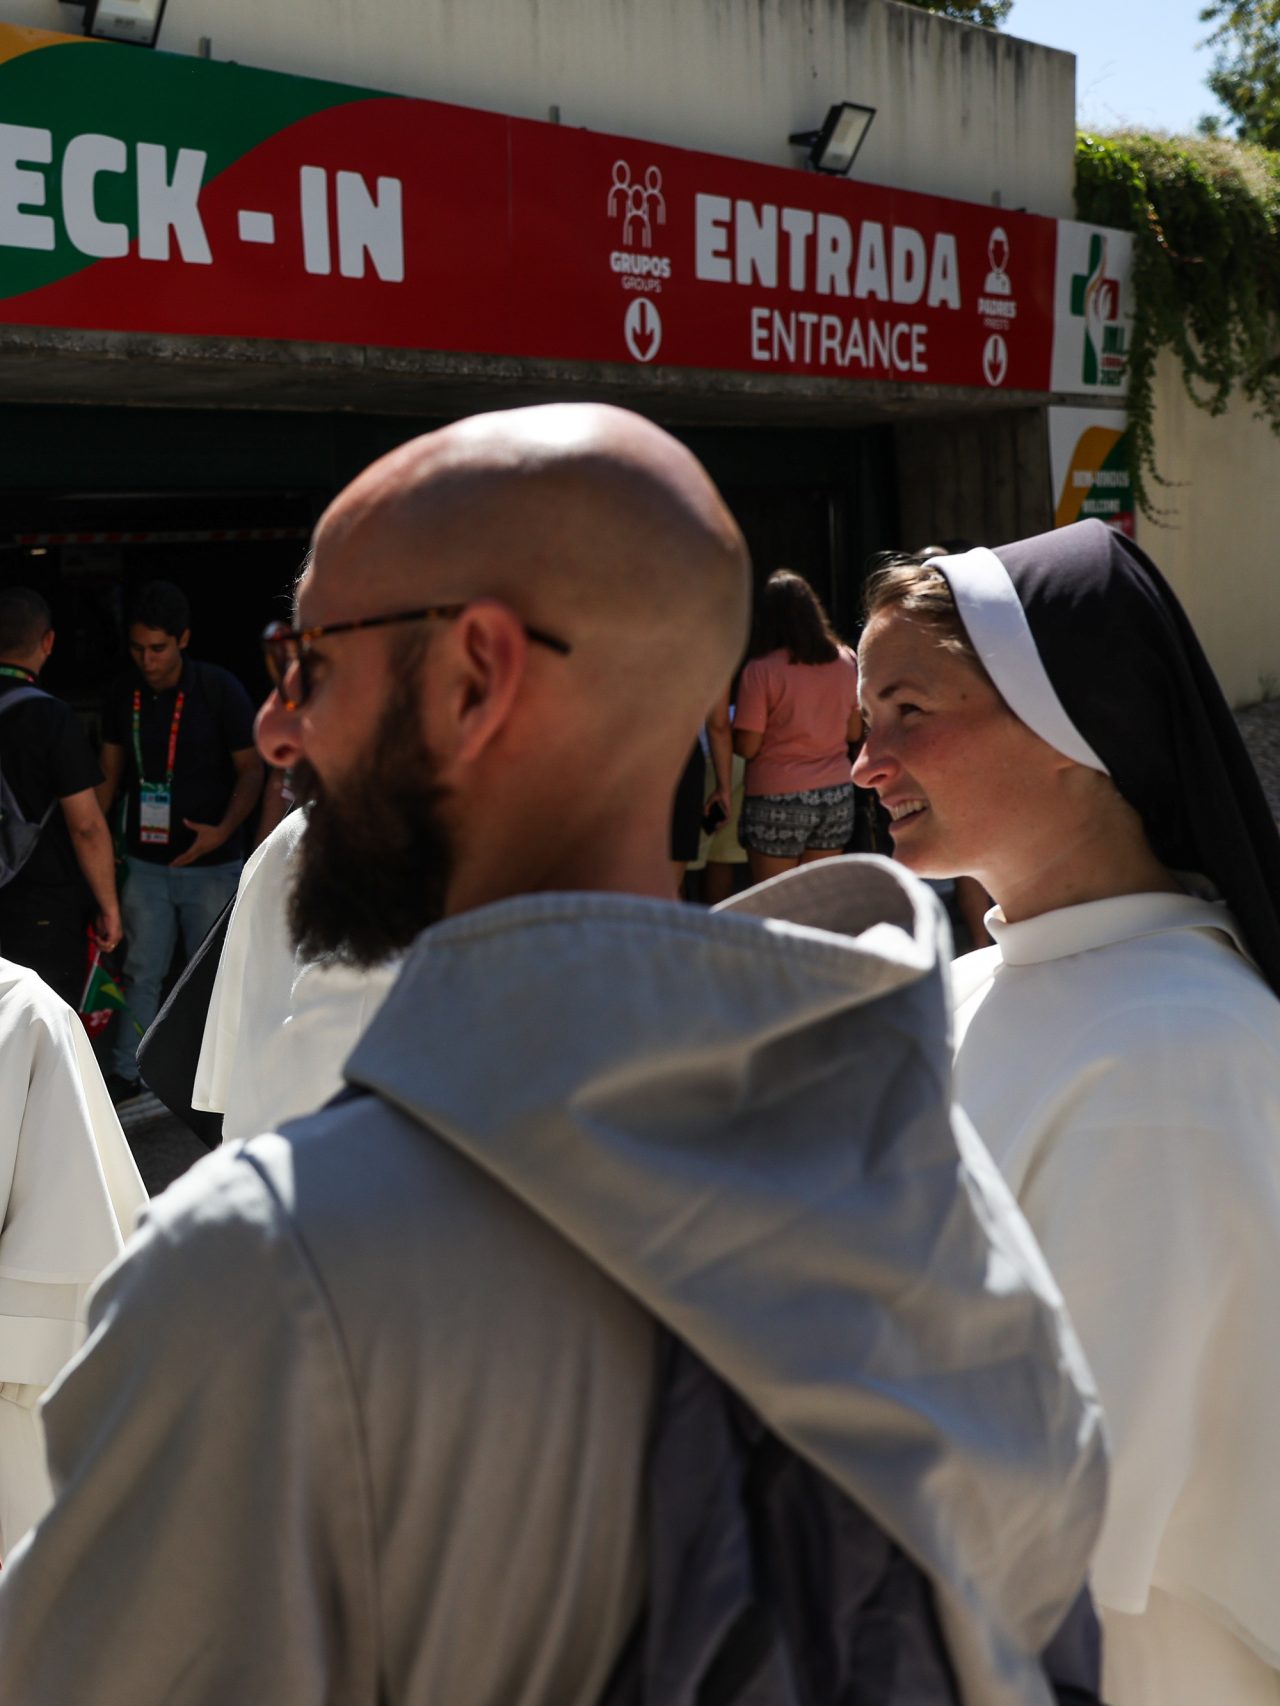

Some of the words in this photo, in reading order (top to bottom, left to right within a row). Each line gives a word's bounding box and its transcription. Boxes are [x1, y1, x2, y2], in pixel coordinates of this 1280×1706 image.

[300, 165, 405, 283] IN
[694, 193, 961, 311] ENTRADA
[610, 250, 671, 279] GRUPOS
[621, 276, 662, 293] GROUPS
[751, 307, 928, 373] ENTRANCE
